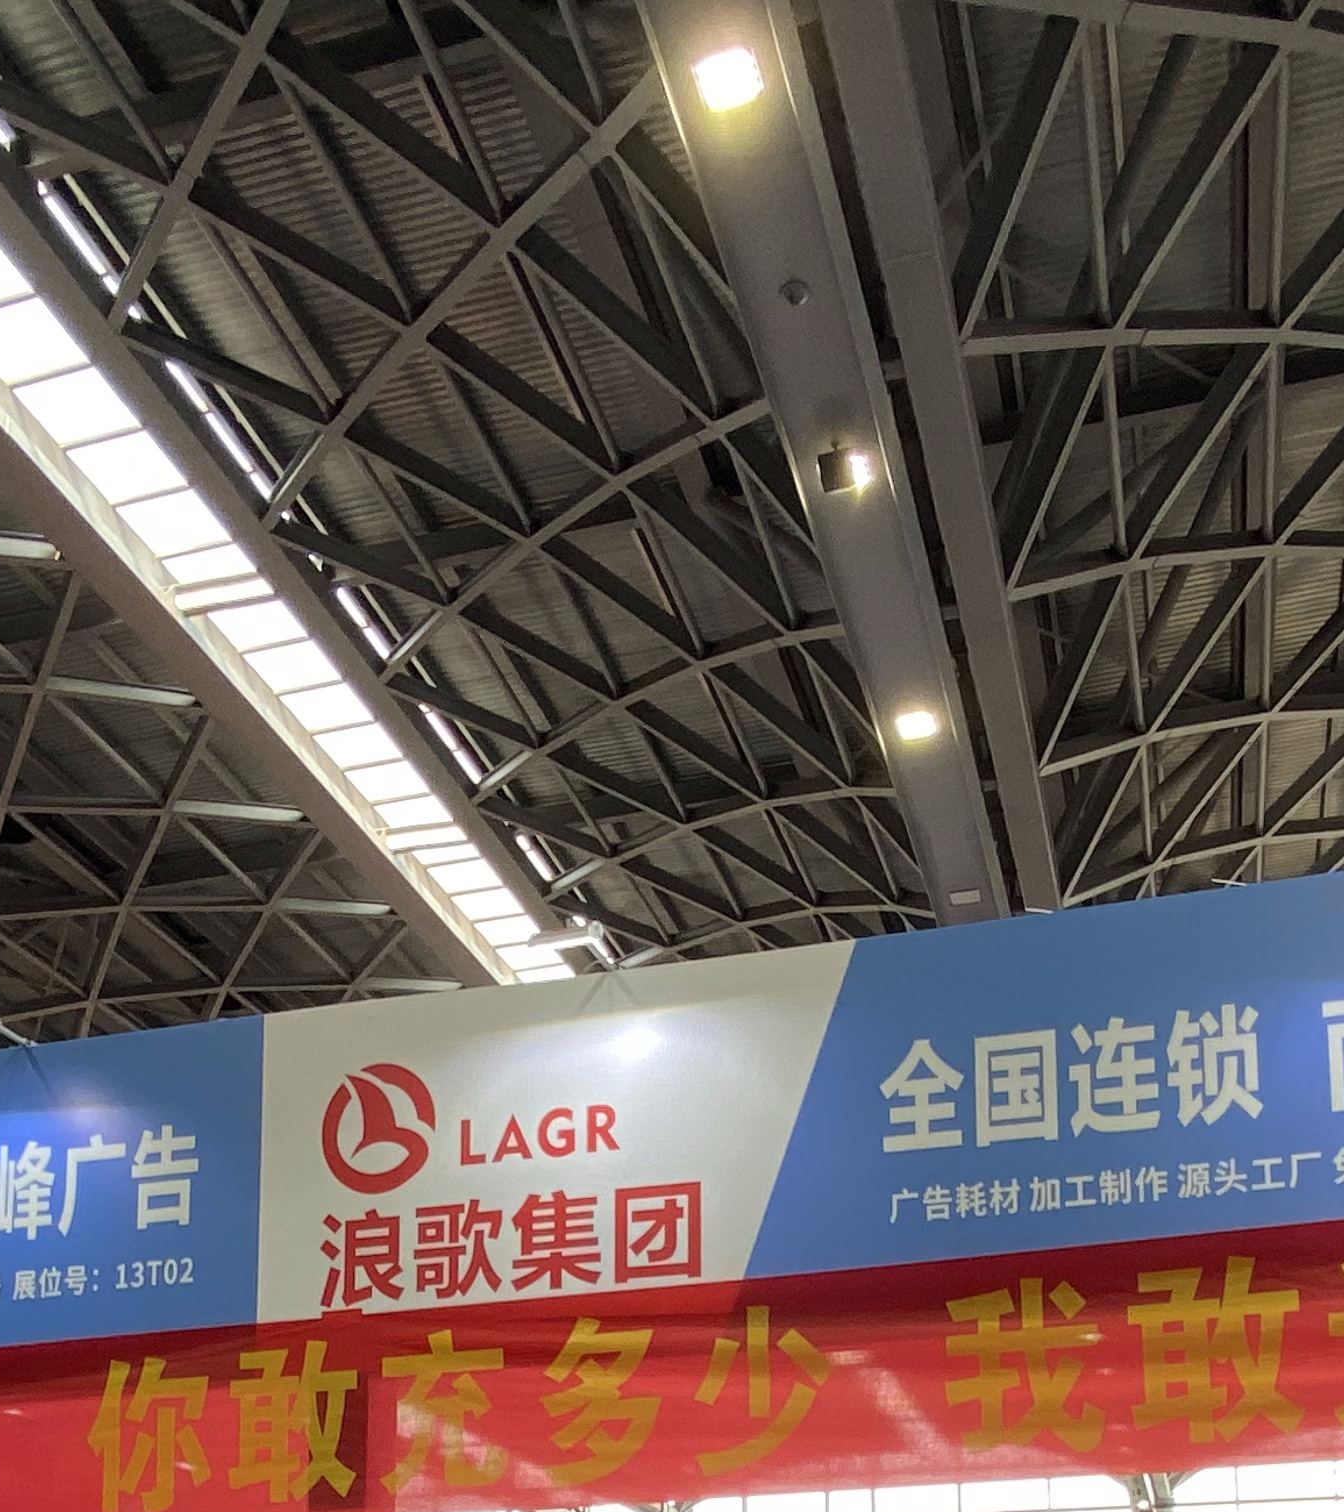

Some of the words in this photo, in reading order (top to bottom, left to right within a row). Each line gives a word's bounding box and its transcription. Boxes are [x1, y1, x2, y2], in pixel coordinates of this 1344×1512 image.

[879, 1003, 1263, 1156] 全国连锁
[460, 1104, 620, 1167] LAGR
[888, 1178, 1021, 1223] 广告耗材
[1029, 1166, 1169, 1214] 加工制作
[1177, 1151, 1321, 1200] 源头工厂
[319, 1180, 704, 1309] 浪歌集团
